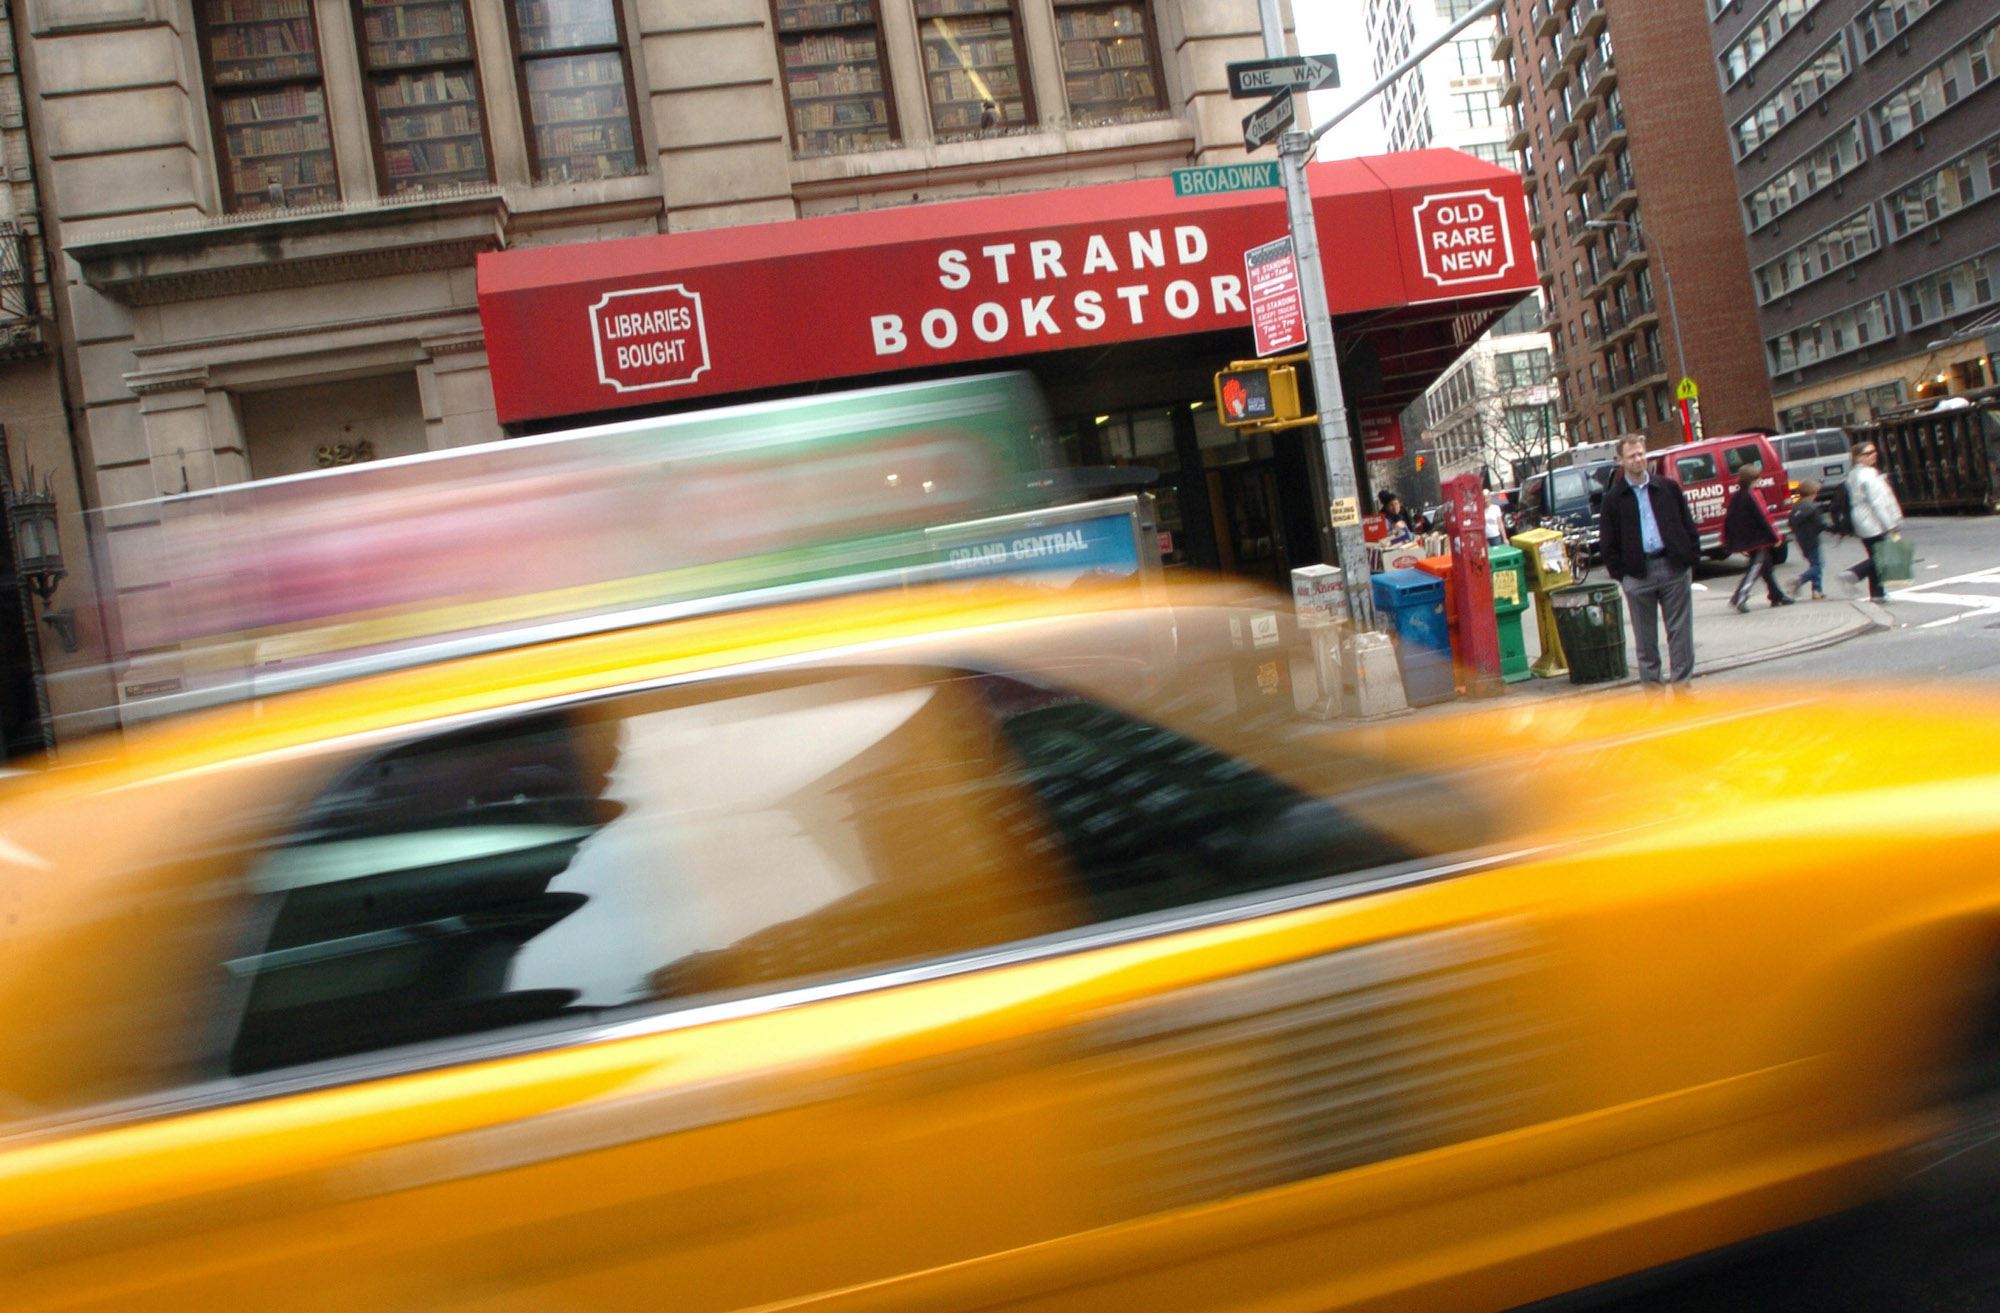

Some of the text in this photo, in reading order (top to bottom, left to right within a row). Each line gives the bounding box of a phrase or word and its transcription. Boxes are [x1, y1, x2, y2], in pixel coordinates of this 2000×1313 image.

[1242, 65, 1323, 87] ONE WAY
[1252, 101, 1291, 138] ONE WAY
[1180, 164, 1272, 193] BROADWAY
[1436, 203, 1484, 225] OLD
[1432, 225, 1496, 250] RARE
[937, 225, 1209, 290] STRAND
[1250, 256, 1291, 277] NO STANDING
[1441, 248, 1493, 273] NEW
[870, 274, 1247, 356] BOOKSTOR
[1256, 295, 1296, 315] NO STANDING
[605, 306, 692, 339] LIBRARIES
[617, 339, 685, 369] BOUGHT
[1683, 484, 1724, 501] TRAND
[951, 529, 1088, 570] GRAND CENTRAL
